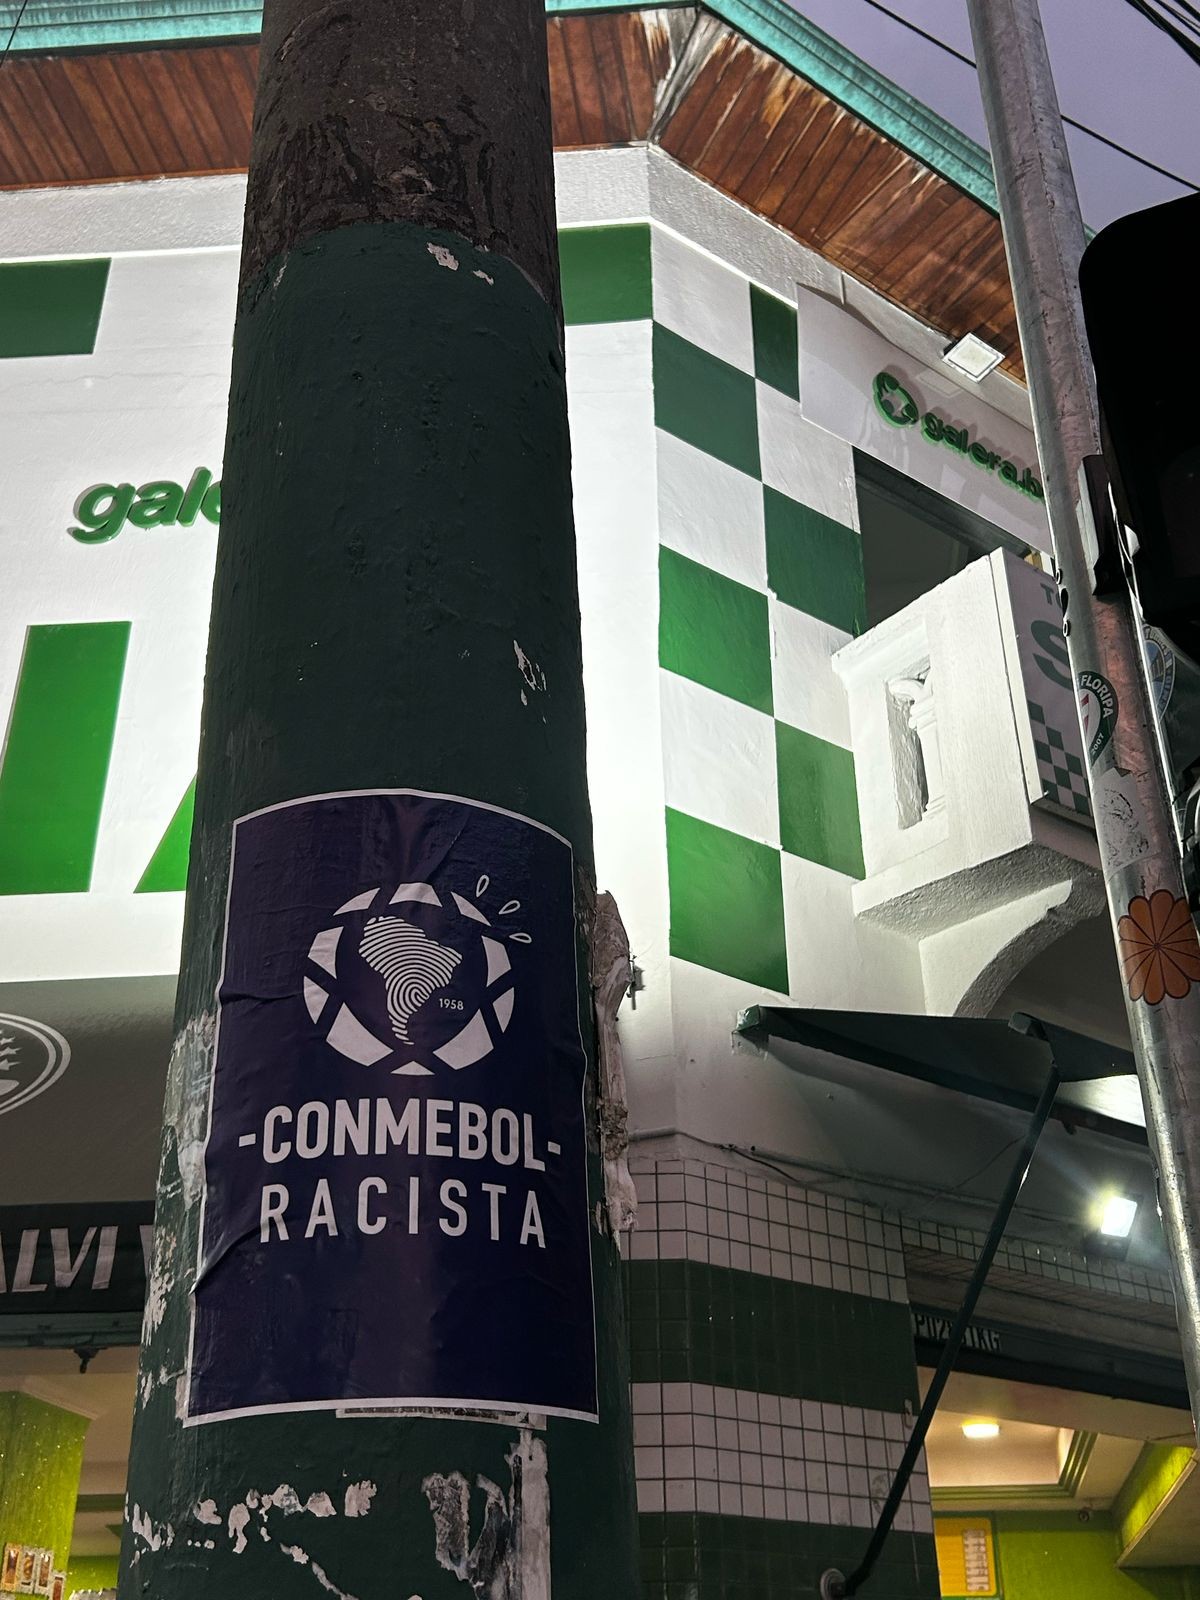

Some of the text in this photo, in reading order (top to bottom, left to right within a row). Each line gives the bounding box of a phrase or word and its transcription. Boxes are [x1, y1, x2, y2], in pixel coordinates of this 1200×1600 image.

[1081, 674, 1114, 719] FLORIPA
[438, 998, 464, 1011] 1958
[259, 1176, 547, 1249] RACISTA
